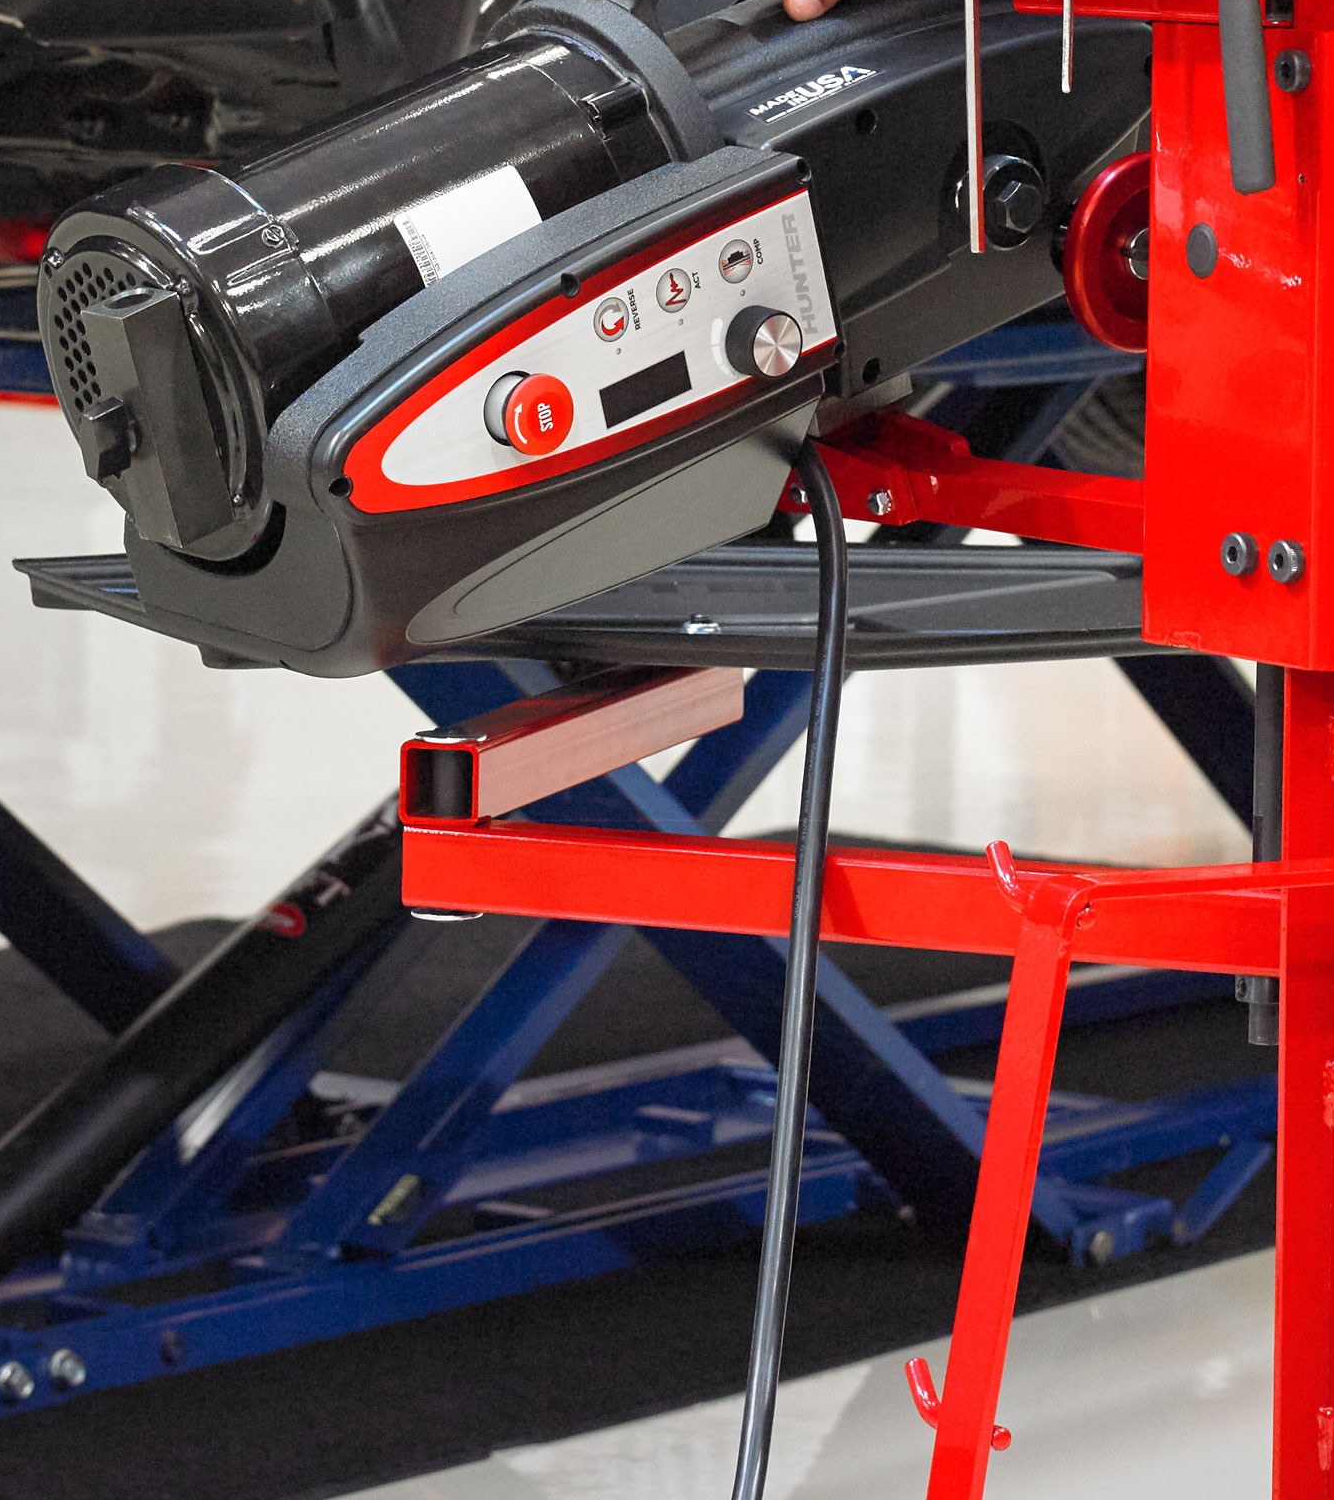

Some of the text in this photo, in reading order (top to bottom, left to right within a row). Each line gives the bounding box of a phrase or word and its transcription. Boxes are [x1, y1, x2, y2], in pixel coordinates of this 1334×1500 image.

[795, 66, 872, 98] USA
[749, 90, 797, 116] MADE
[787, 93, 808, 107] IN
[753, 238, 764, 265] COMP
[692, 271, 701, 289] ACT
[780, 211, 819, 335] HUNTER
[627, 288, 642, 331] REVERSE
[537, 402, 554, 432] STOP
